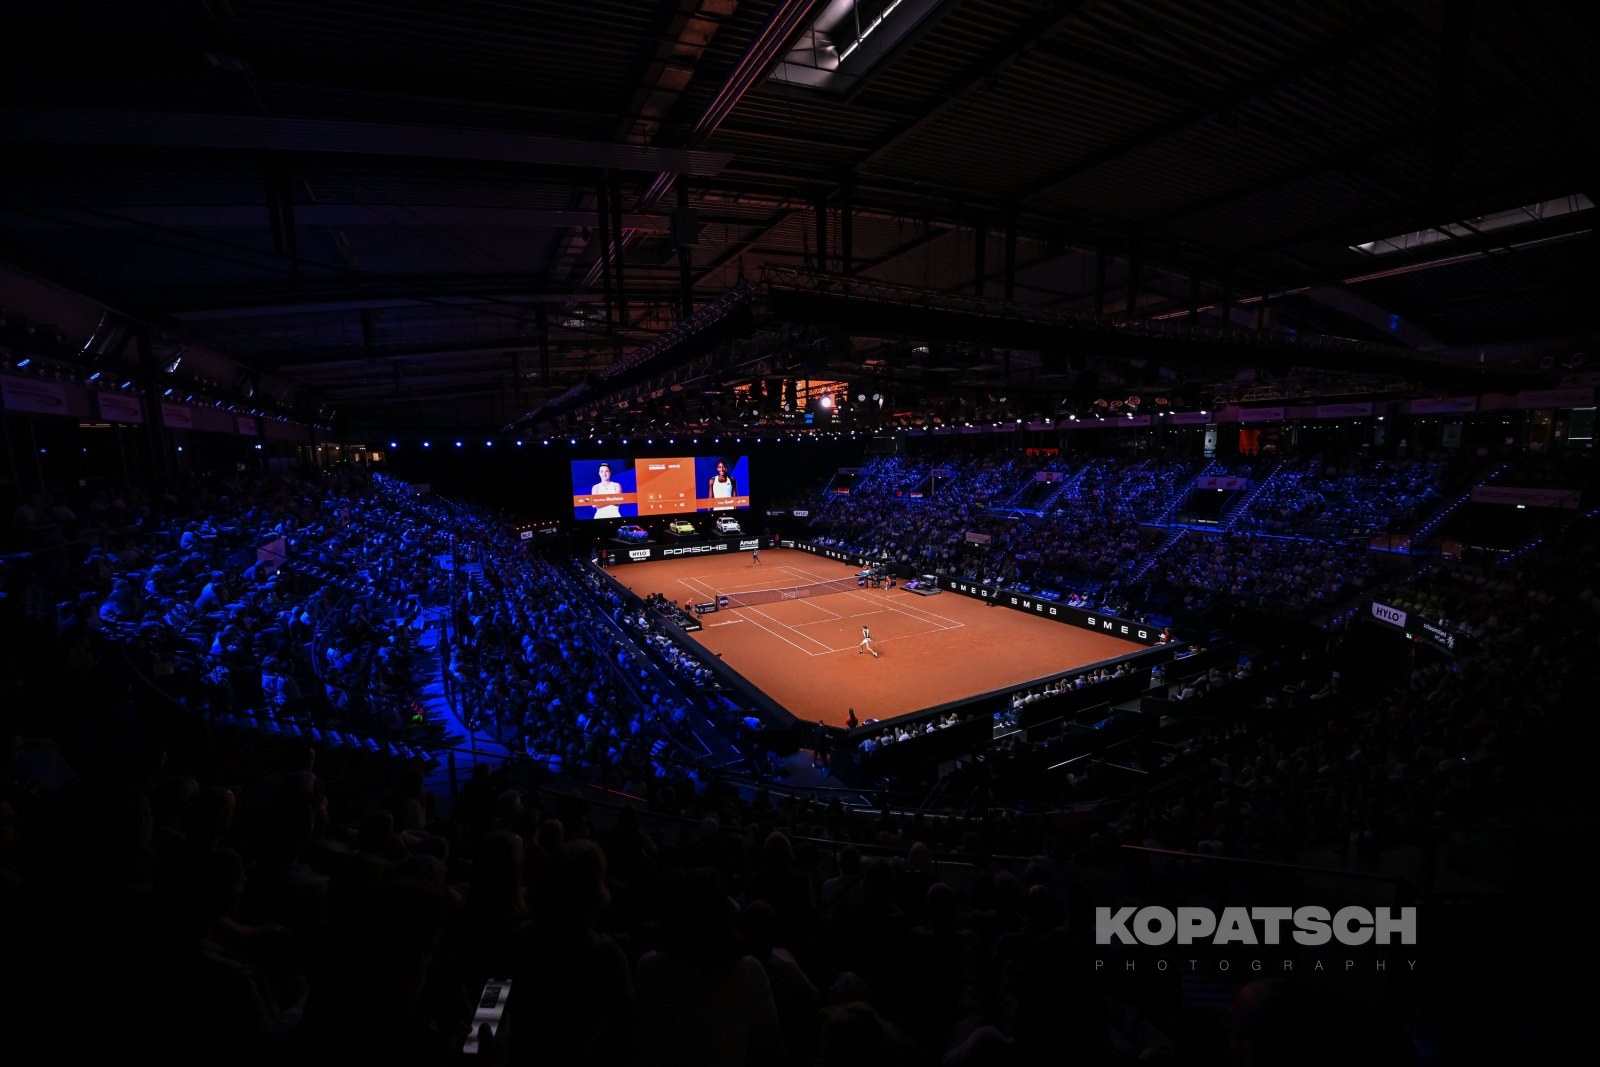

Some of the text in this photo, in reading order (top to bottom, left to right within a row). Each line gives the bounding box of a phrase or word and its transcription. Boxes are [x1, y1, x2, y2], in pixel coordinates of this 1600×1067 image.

[664, 544, 728, 556] PORSCHE
[950, 581, 988, 597] SMEG
[1011, 597, 1057, 615] SMEG
[1376, 606, 1400, 622] HYLO
[1088, 617, 1148, 639] SMEG
